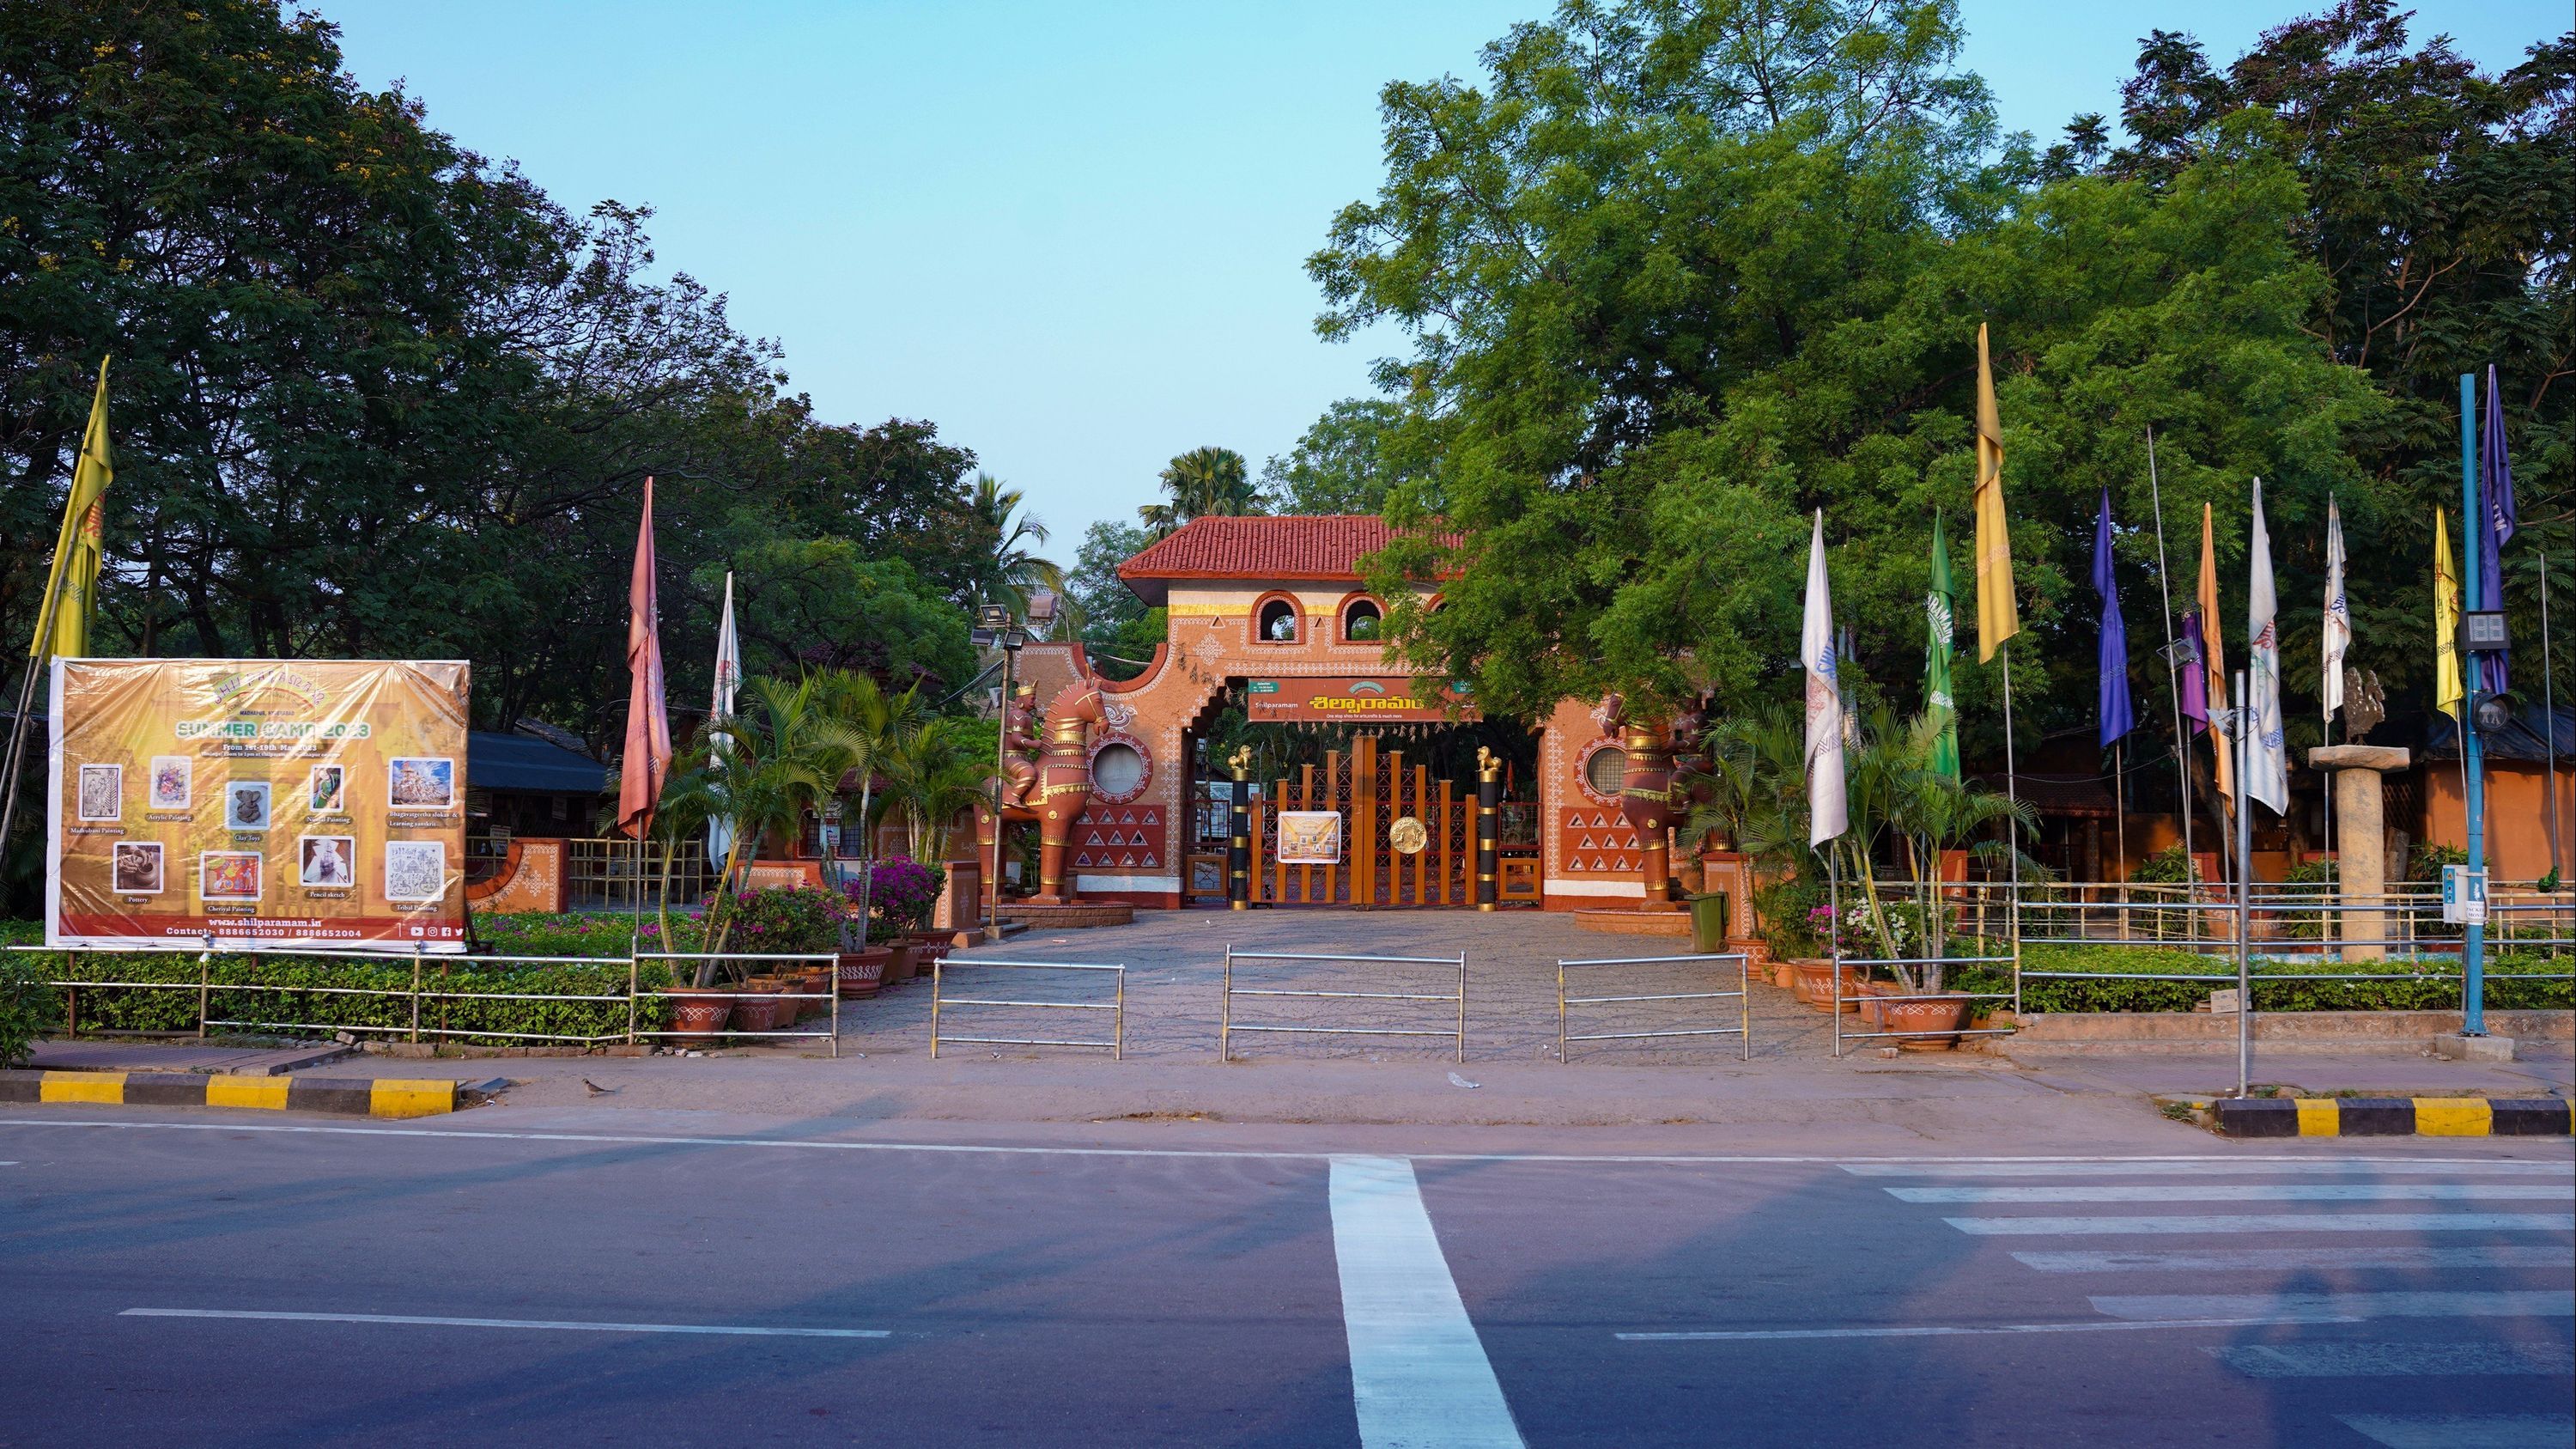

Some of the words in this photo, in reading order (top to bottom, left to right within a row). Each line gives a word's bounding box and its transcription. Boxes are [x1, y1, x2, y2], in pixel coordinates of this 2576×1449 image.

[177, 723, 256, 737] SUMMER
[263, 723, 315, 737] CAMP
[128, 896, 149, 904] Pottery
[208, 905, 230, 914] Cheriyal
[231, 905, 255, 914] Painting
[209, 918, 322, 929] www.shilparamam.in
[295, 928, 361, 937] 8886652004
